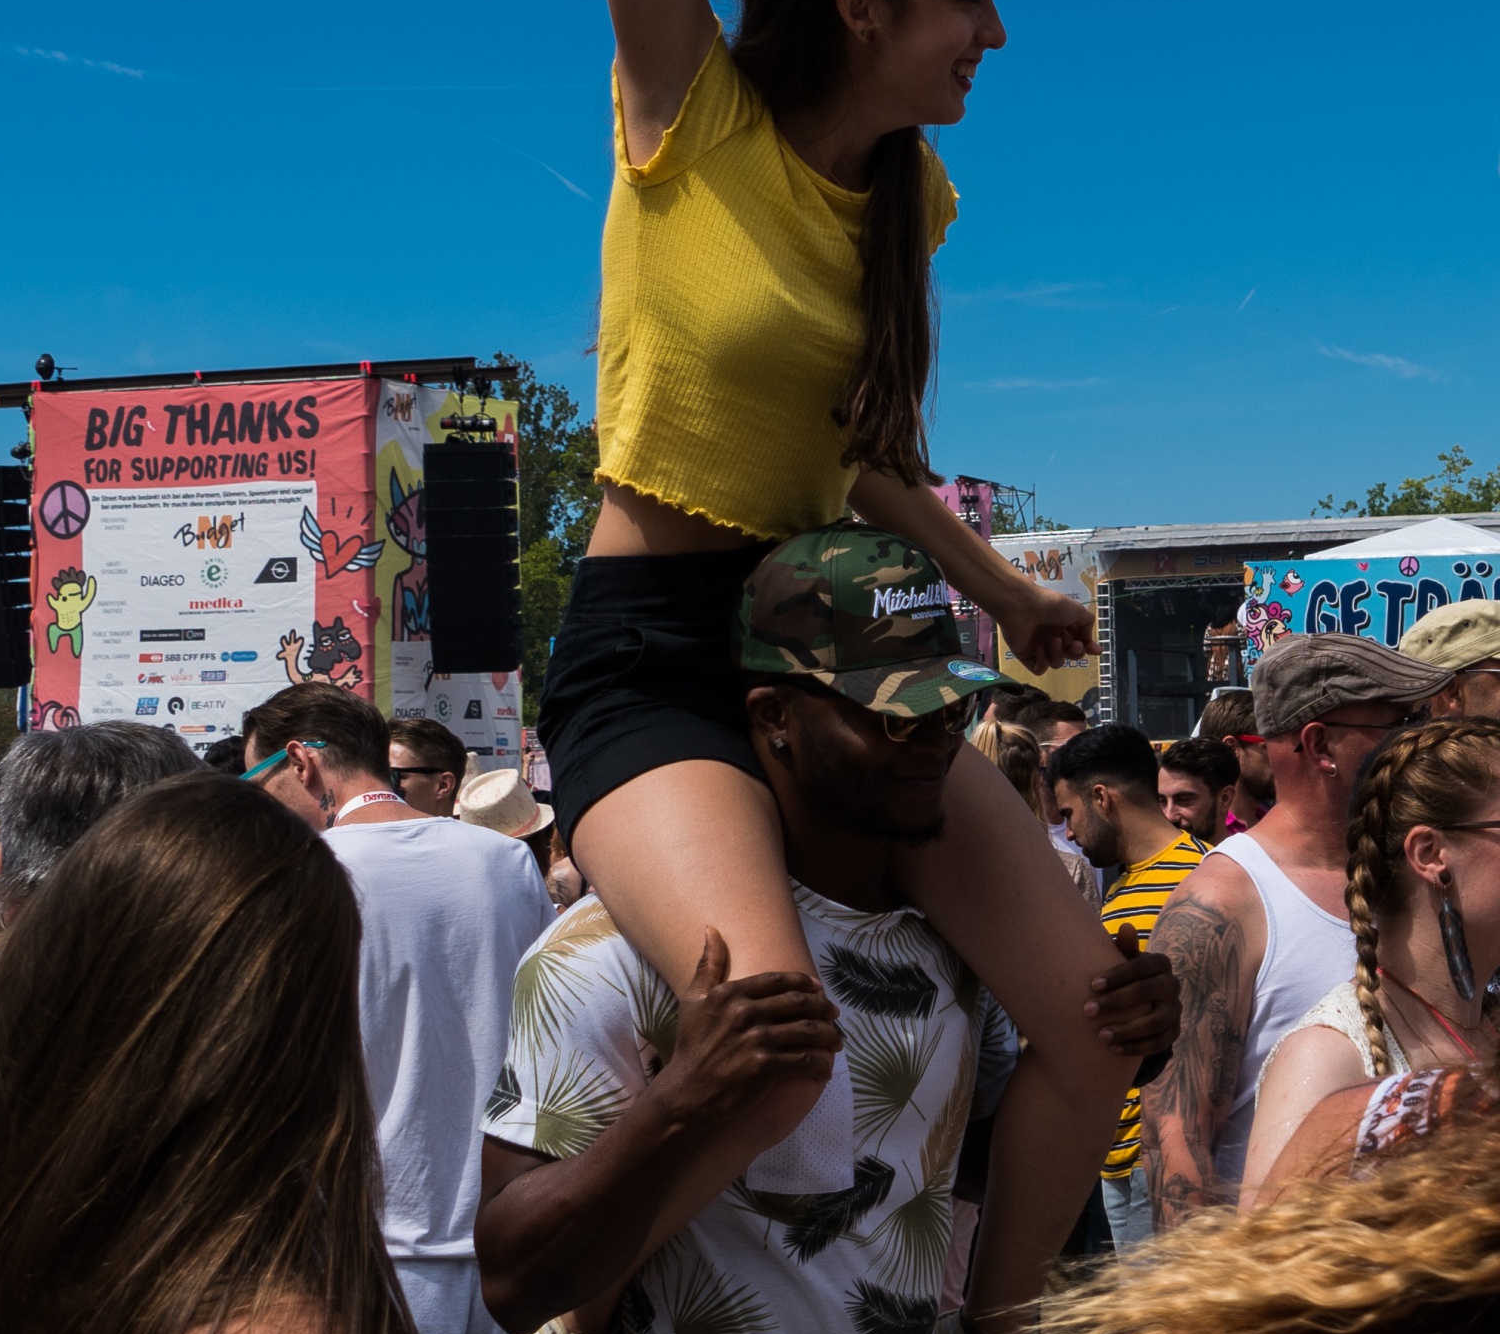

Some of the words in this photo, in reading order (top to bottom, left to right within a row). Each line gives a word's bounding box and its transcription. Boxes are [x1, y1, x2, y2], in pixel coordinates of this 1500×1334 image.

[84, 405, 147, 451] BIG
[163, 395, 320, 446] THANKS
[84, 457, 122, 484] FOR
[131, 452, 268, 482] SUPPORTING
[278, 449, 316, 478] US!
[173, 512, 245, 549] Budget
[1010, 546, 1073, 581] Budget
[141, 574, 185, 587] DIAGEO
[189, 597, 243, 610] medica
[164, 654, 181, 662] SBB
[183, 653, 198, 661] CFF
[170, 673, 194, 682] valais
[139, 698, 159, 706] TELE
[191, 700, 227, 710] BE-AT.TV
[395, 708, 426, 719] DIAGEO
